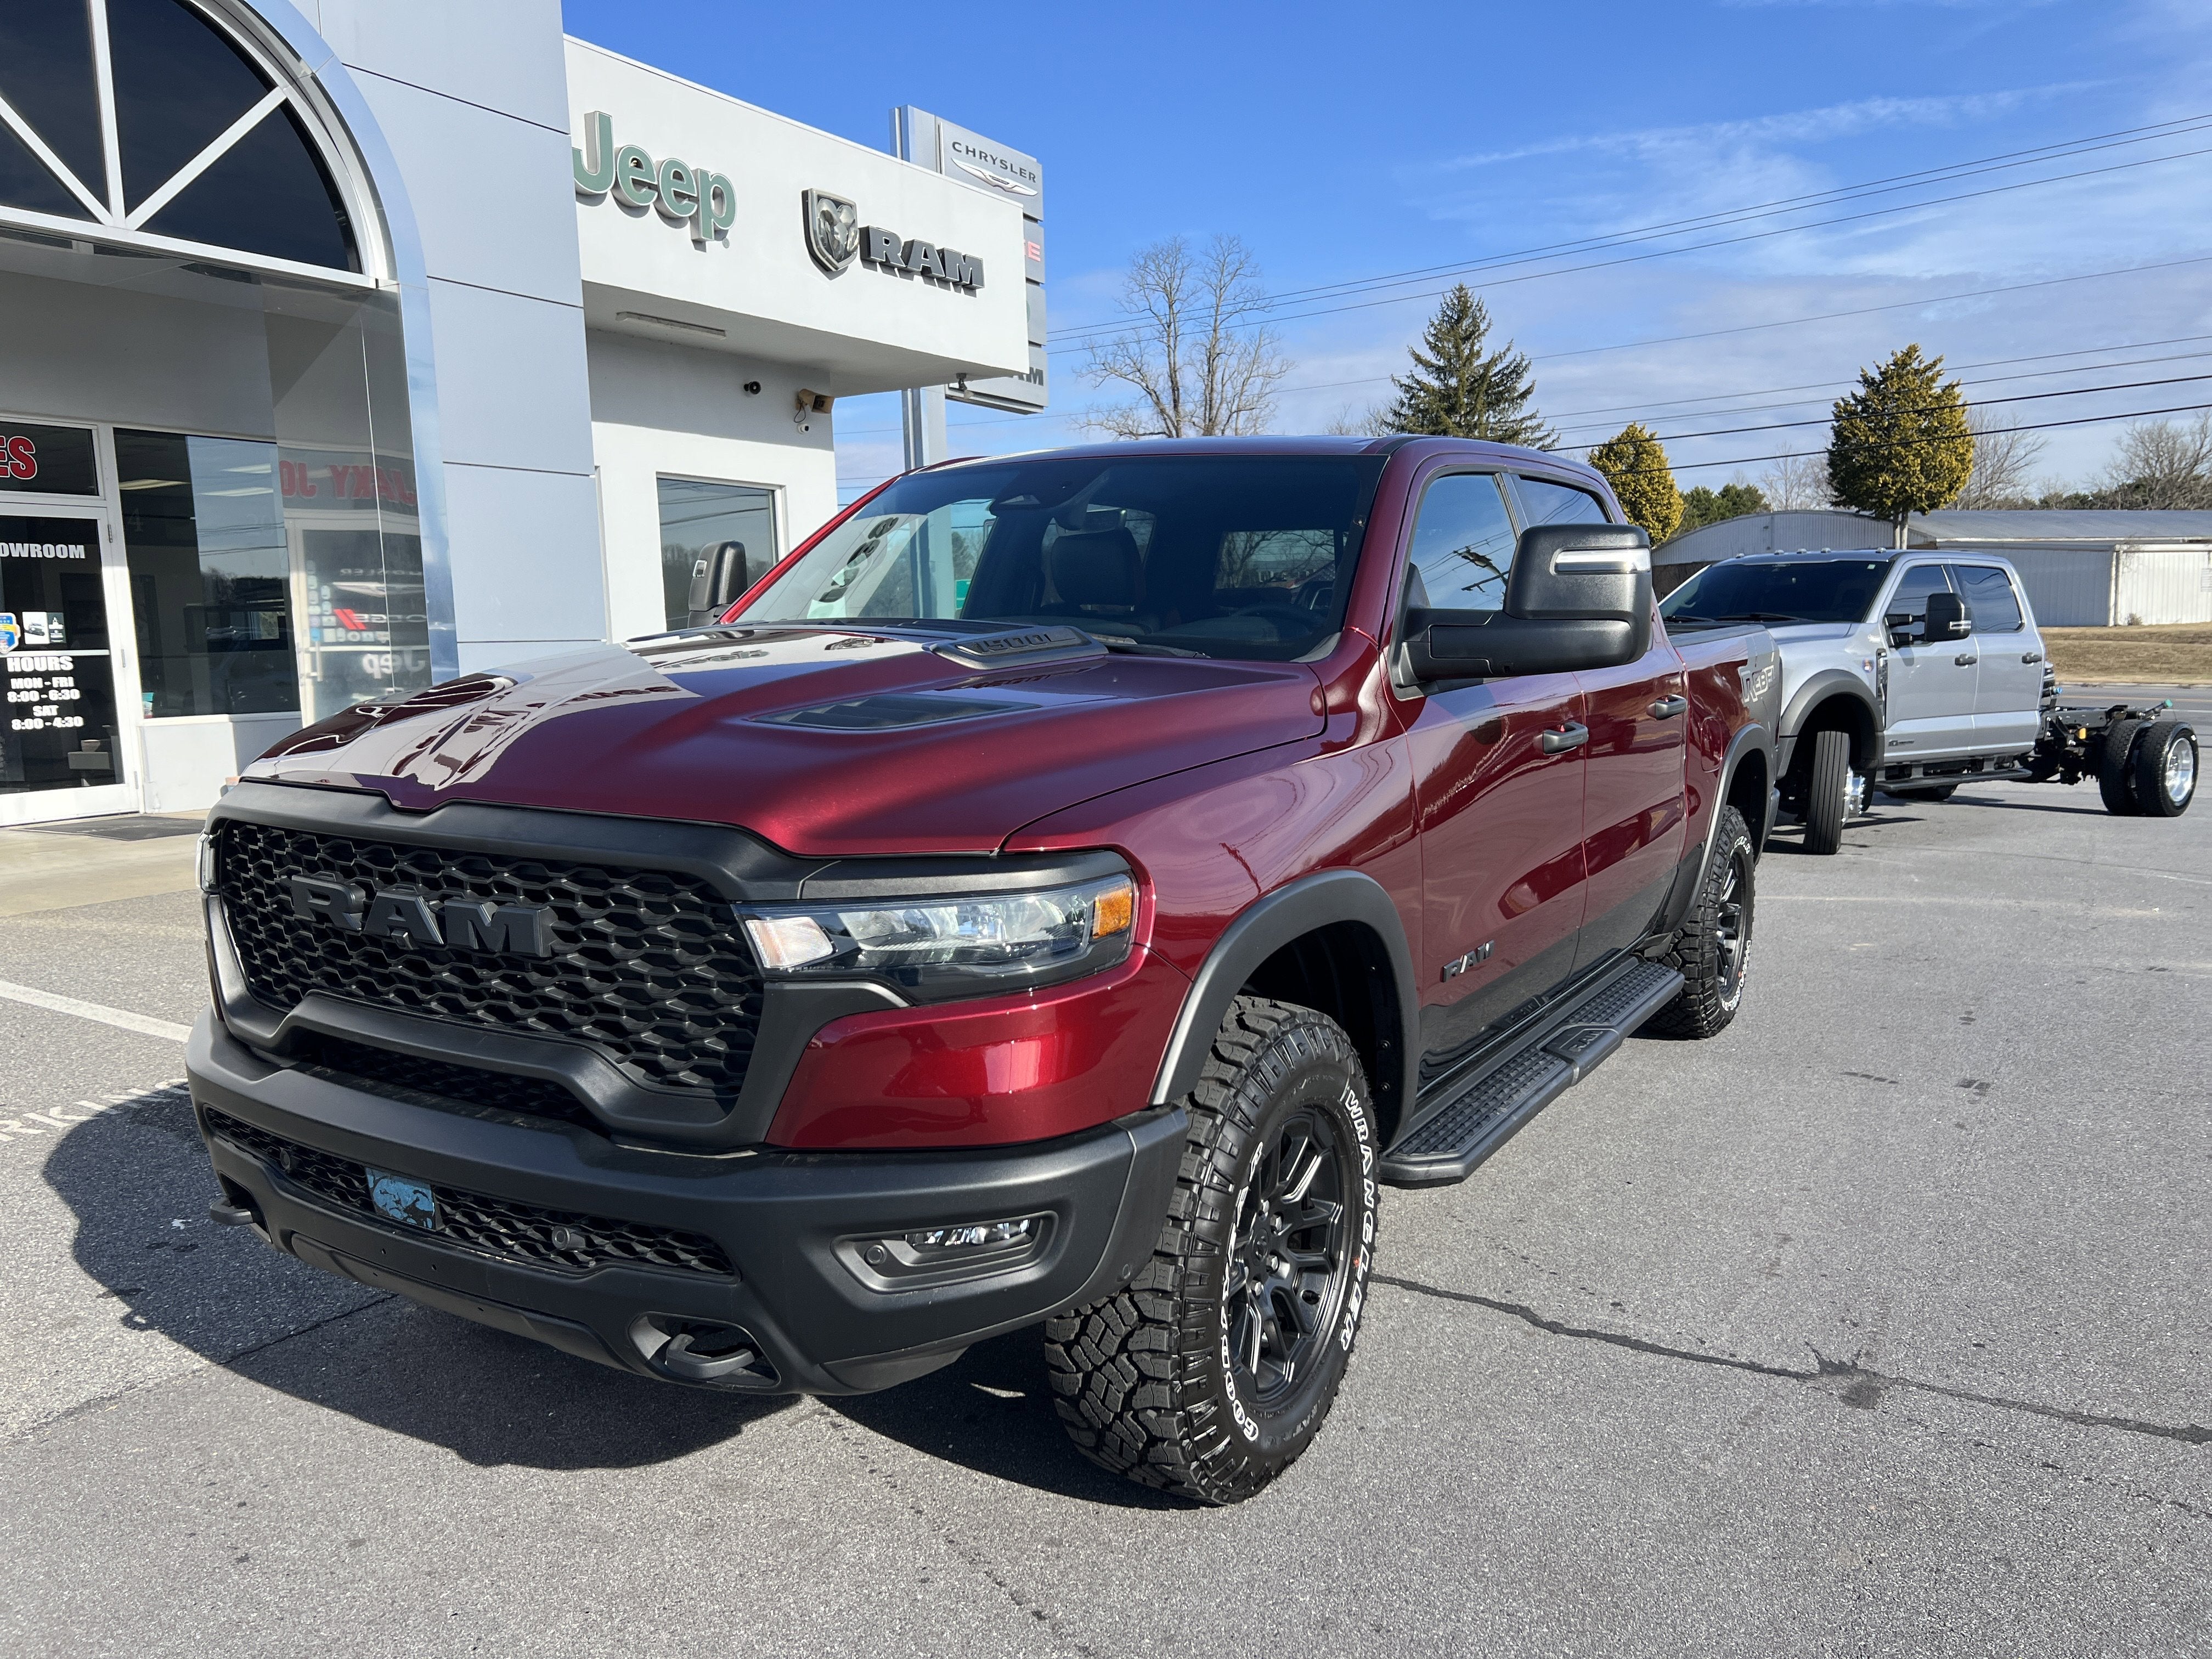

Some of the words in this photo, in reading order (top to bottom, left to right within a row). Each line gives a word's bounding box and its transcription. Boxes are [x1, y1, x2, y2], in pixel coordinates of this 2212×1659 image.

[572, 110, 737, 240] Jeep
[952, 140, 1036, 183] CHRYSLER
[860, 225, 985, 289] RAM
[973, 634, 1047, 653] 1500
[7, 656, 74, 672] HOURS
[7, 691, 40, 703] 8:00
[48, 689, 81, 701] 6:30
[10, 677, 43, 689] MON
[52, 676, 75, 688] FRI
[11, 718, 44, 730] 8:00
[52, 716, 84, 728] 4:30
[32, 704, 59, 716] SAT
[291, 874, 551, 958] RAM
[1441, 939, 1495, 983] RAM
[1340, 1089, 1374, 1351] WRANGLER
